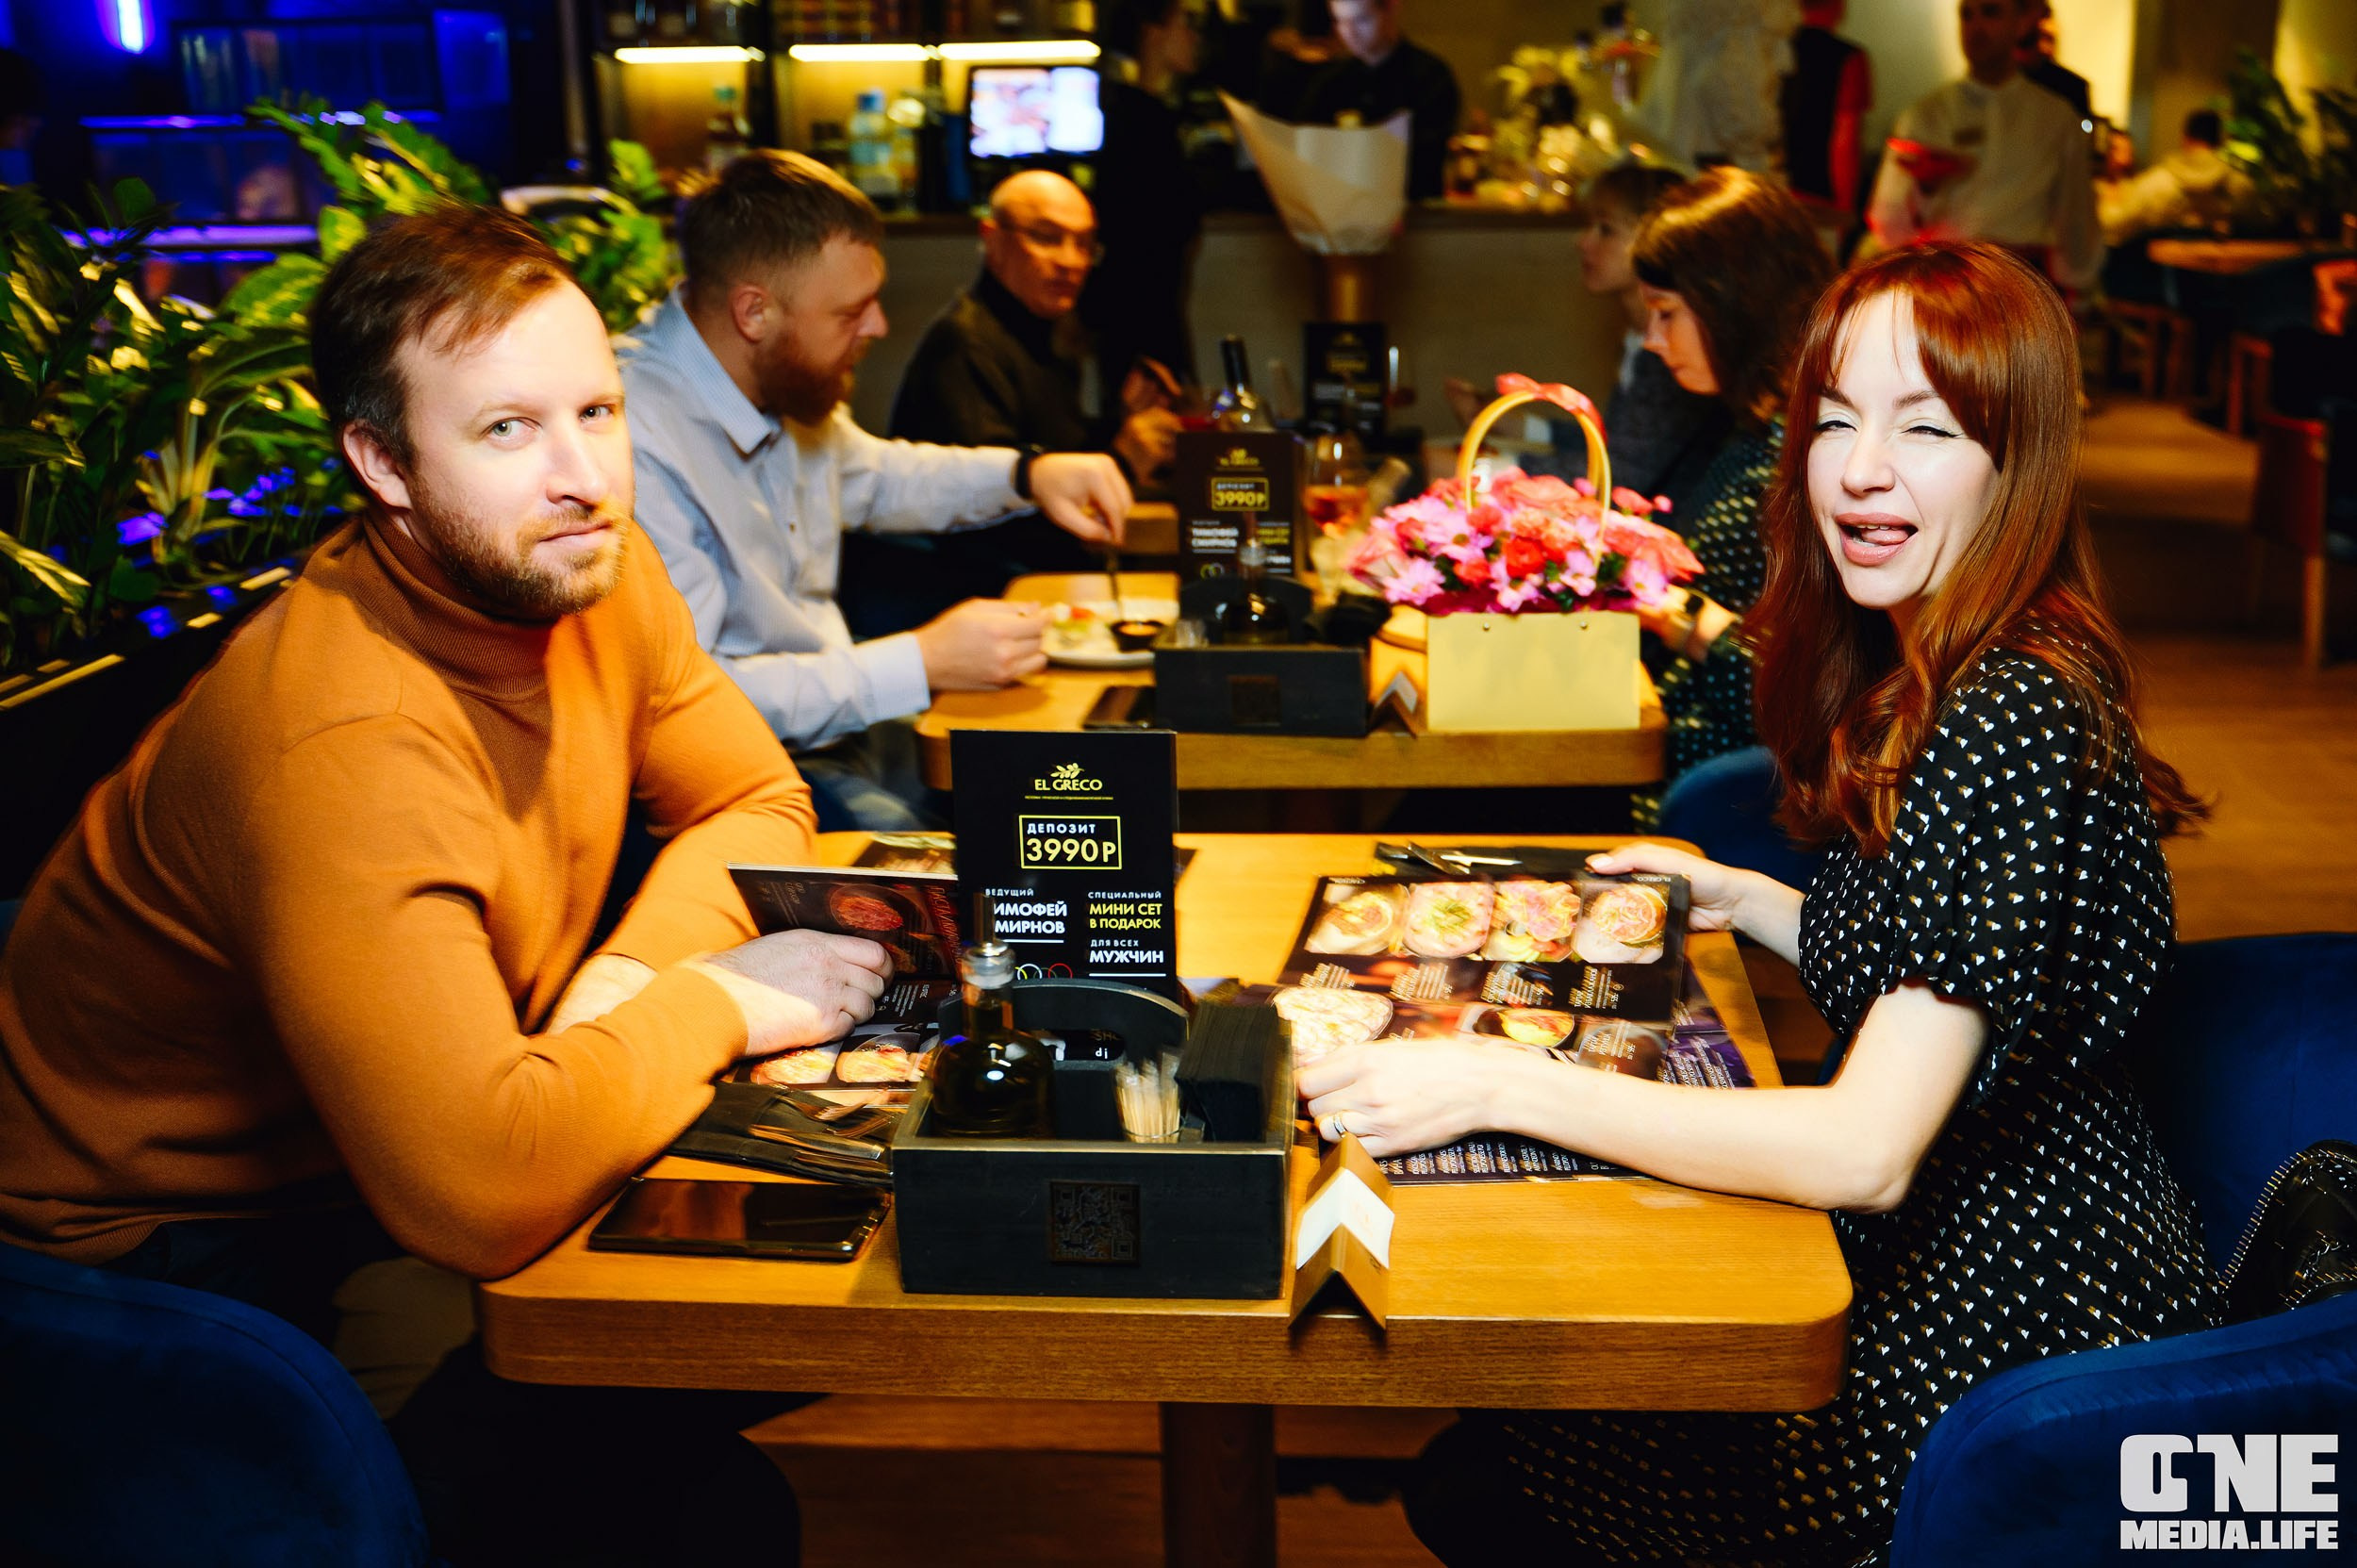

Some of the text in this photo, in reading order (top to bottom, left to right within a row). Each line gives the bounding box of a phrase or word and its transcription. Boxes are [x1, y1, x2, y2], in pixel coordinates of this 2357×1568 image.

[1034, 779, 1103, 791] EL GRECO
[1027, 823, 1096, 835] ДЕПОЗИТ
[985, 888, 1034, 897] ВЕДУЩИЙ
[1087, 891, 1162, 900] СПЕЦИАЛЬНЫЙ
[994, 900, 1067, 916] ИМОФЕЙ
[1089, 903, 1162, 916] МИНИ СЕТ
[995, 920, 1065, 934] МИРНОВ
[1089, 918, 1162, 931] В ПОДАРОК
[1091, 939, 1111, 948] ДЛЯ
[1089, 949, 1164, 964] МУЖЧИН
